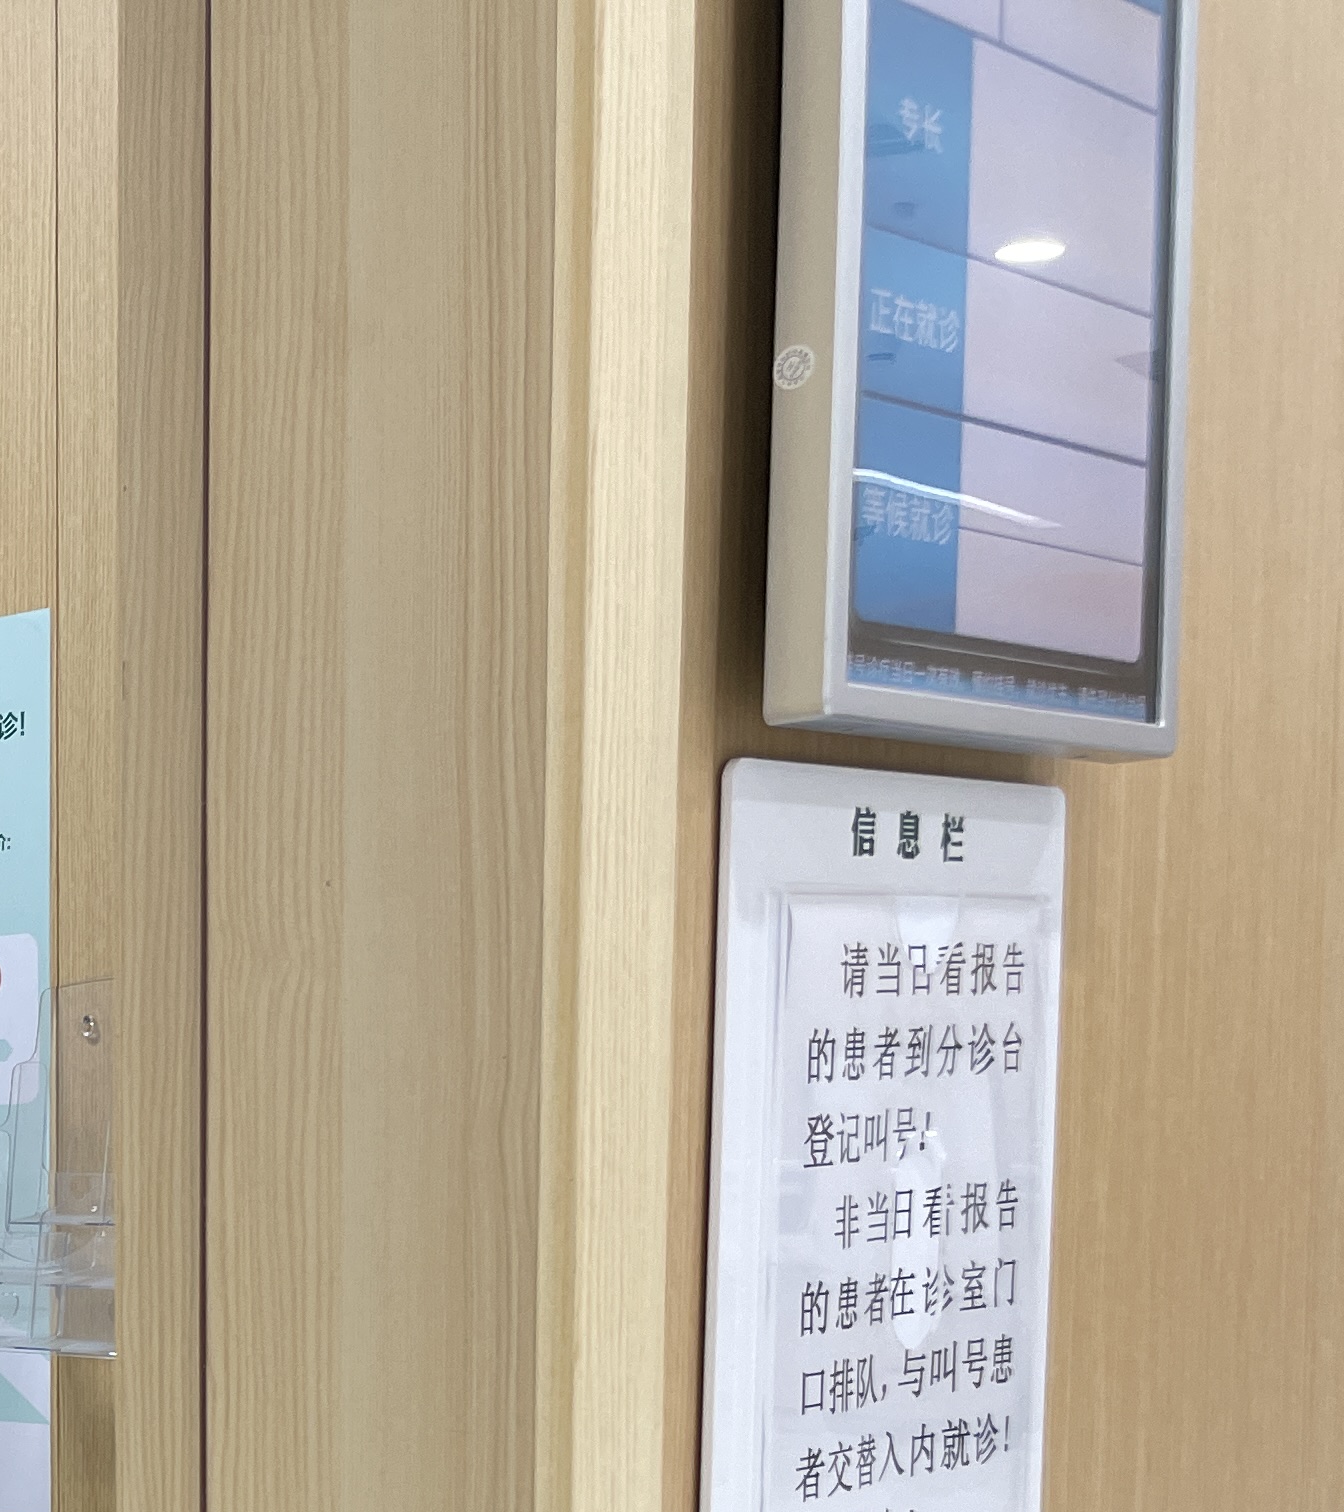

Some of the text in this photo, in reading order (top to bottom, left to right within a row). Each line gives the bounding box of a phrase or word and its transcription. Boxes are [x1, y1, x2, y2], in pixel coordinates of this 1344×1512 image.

[869, 288, 959, 354] 正在就诊
[840, 941, 1025, 998] 请当日看报告
[807, 1021, 1023, 1084] 的患者到分诊台
[834, 1179, 1019, 1249] 非当日看报告
[800, 1258, 1017, 1338] 的患者在诊室门
